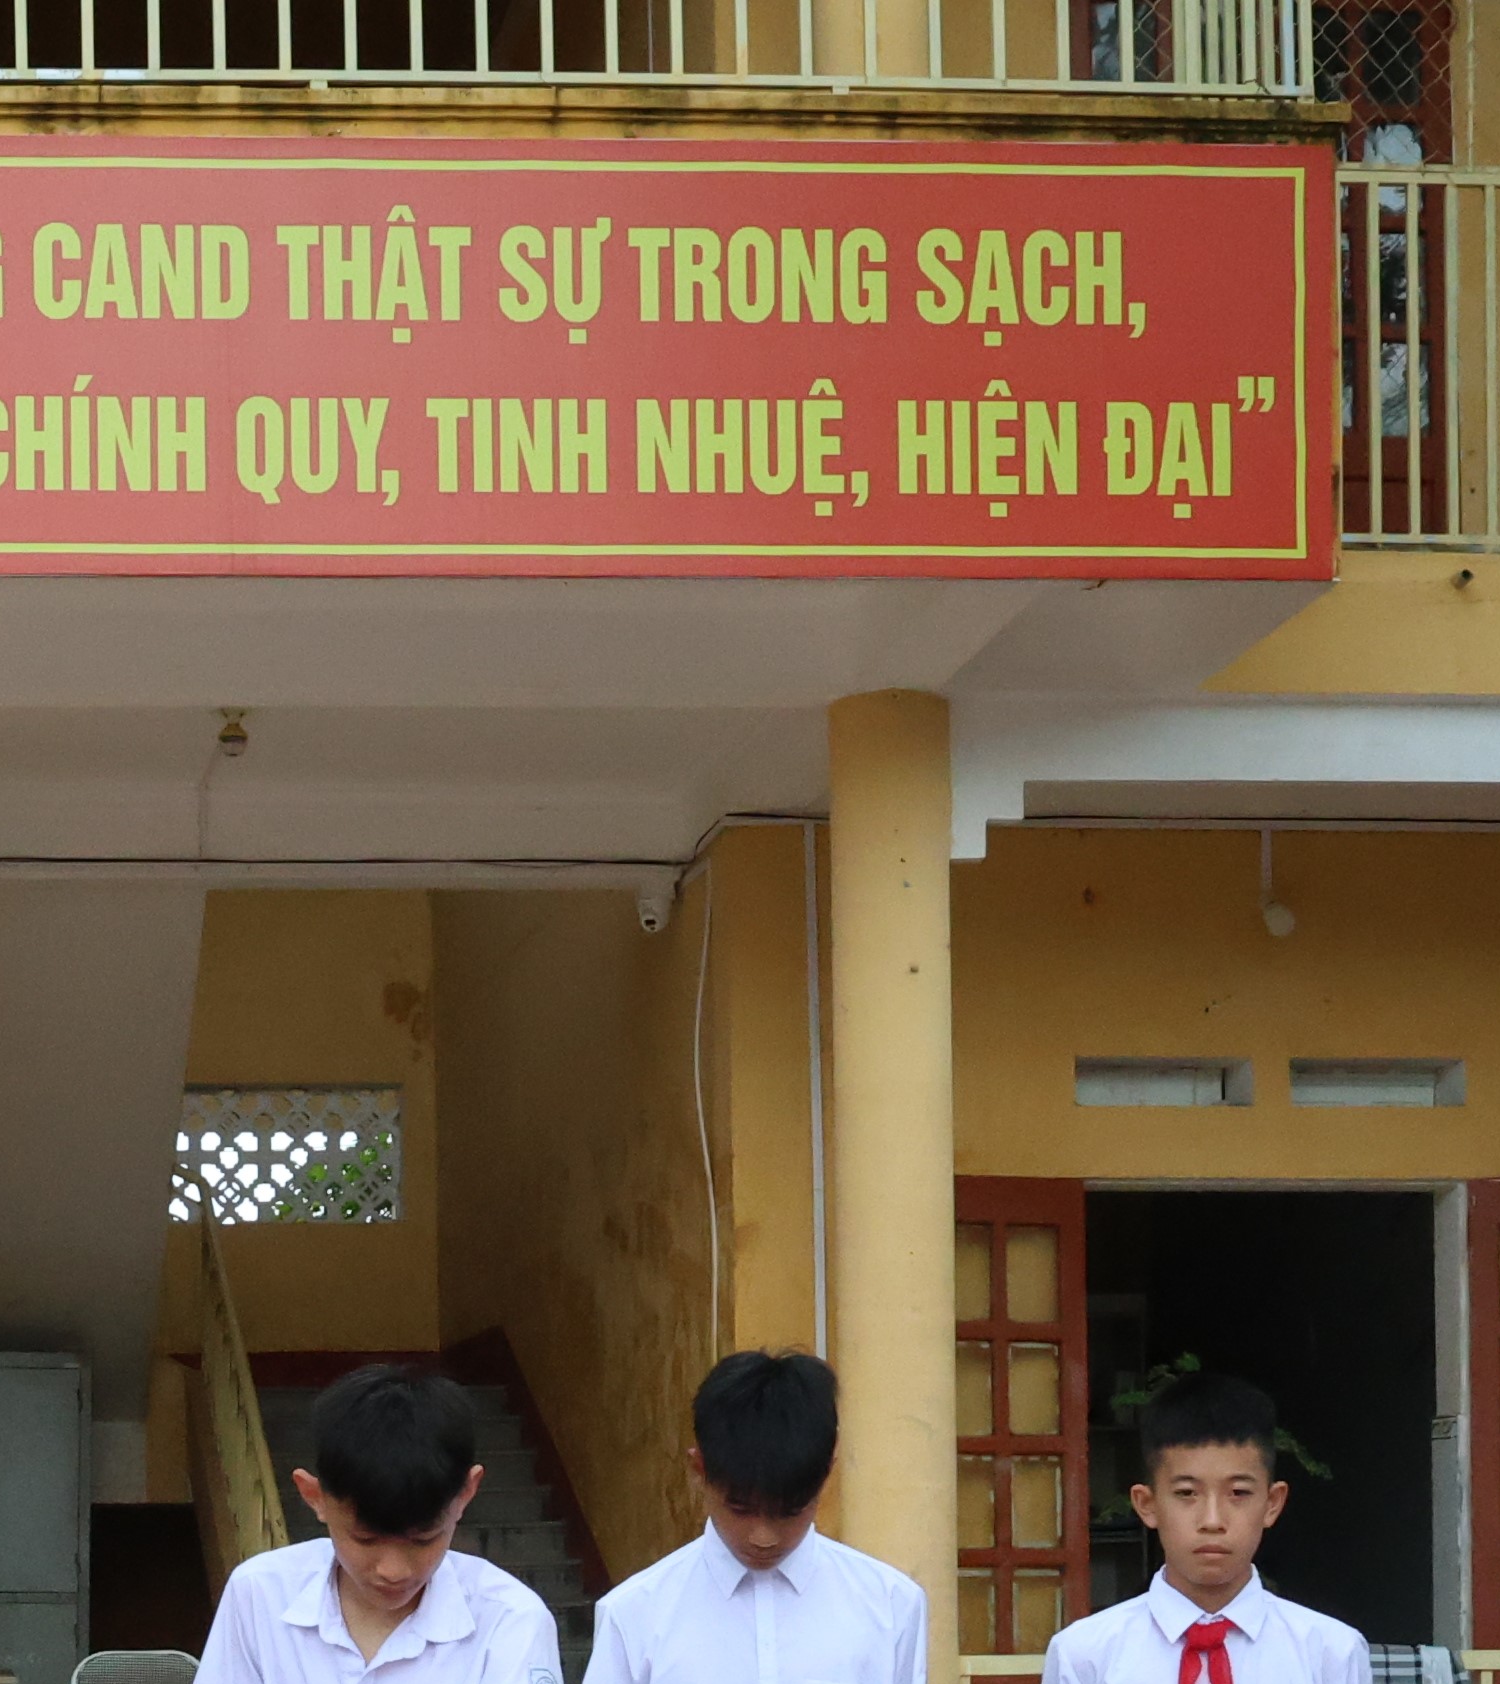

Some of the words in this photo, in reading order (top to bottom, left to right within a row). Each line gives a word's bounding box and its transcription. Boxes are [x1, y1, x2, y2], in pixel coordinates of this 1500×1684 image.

[31, 220, 252, 324] CAND
[275, 203, 472, 343] THẬT
[497, 214, 610, 343] SỰ
[625, 222, 888, 325] TRONG
[913, 227, 1148, 346] SẠCH,
[232, 398, 402, 504] QUY,
[424, 398, 608, 497] TINH
[632, 376, 872, 517] NHUỆ,
[895, 377, 1076, 517] HIỆN
